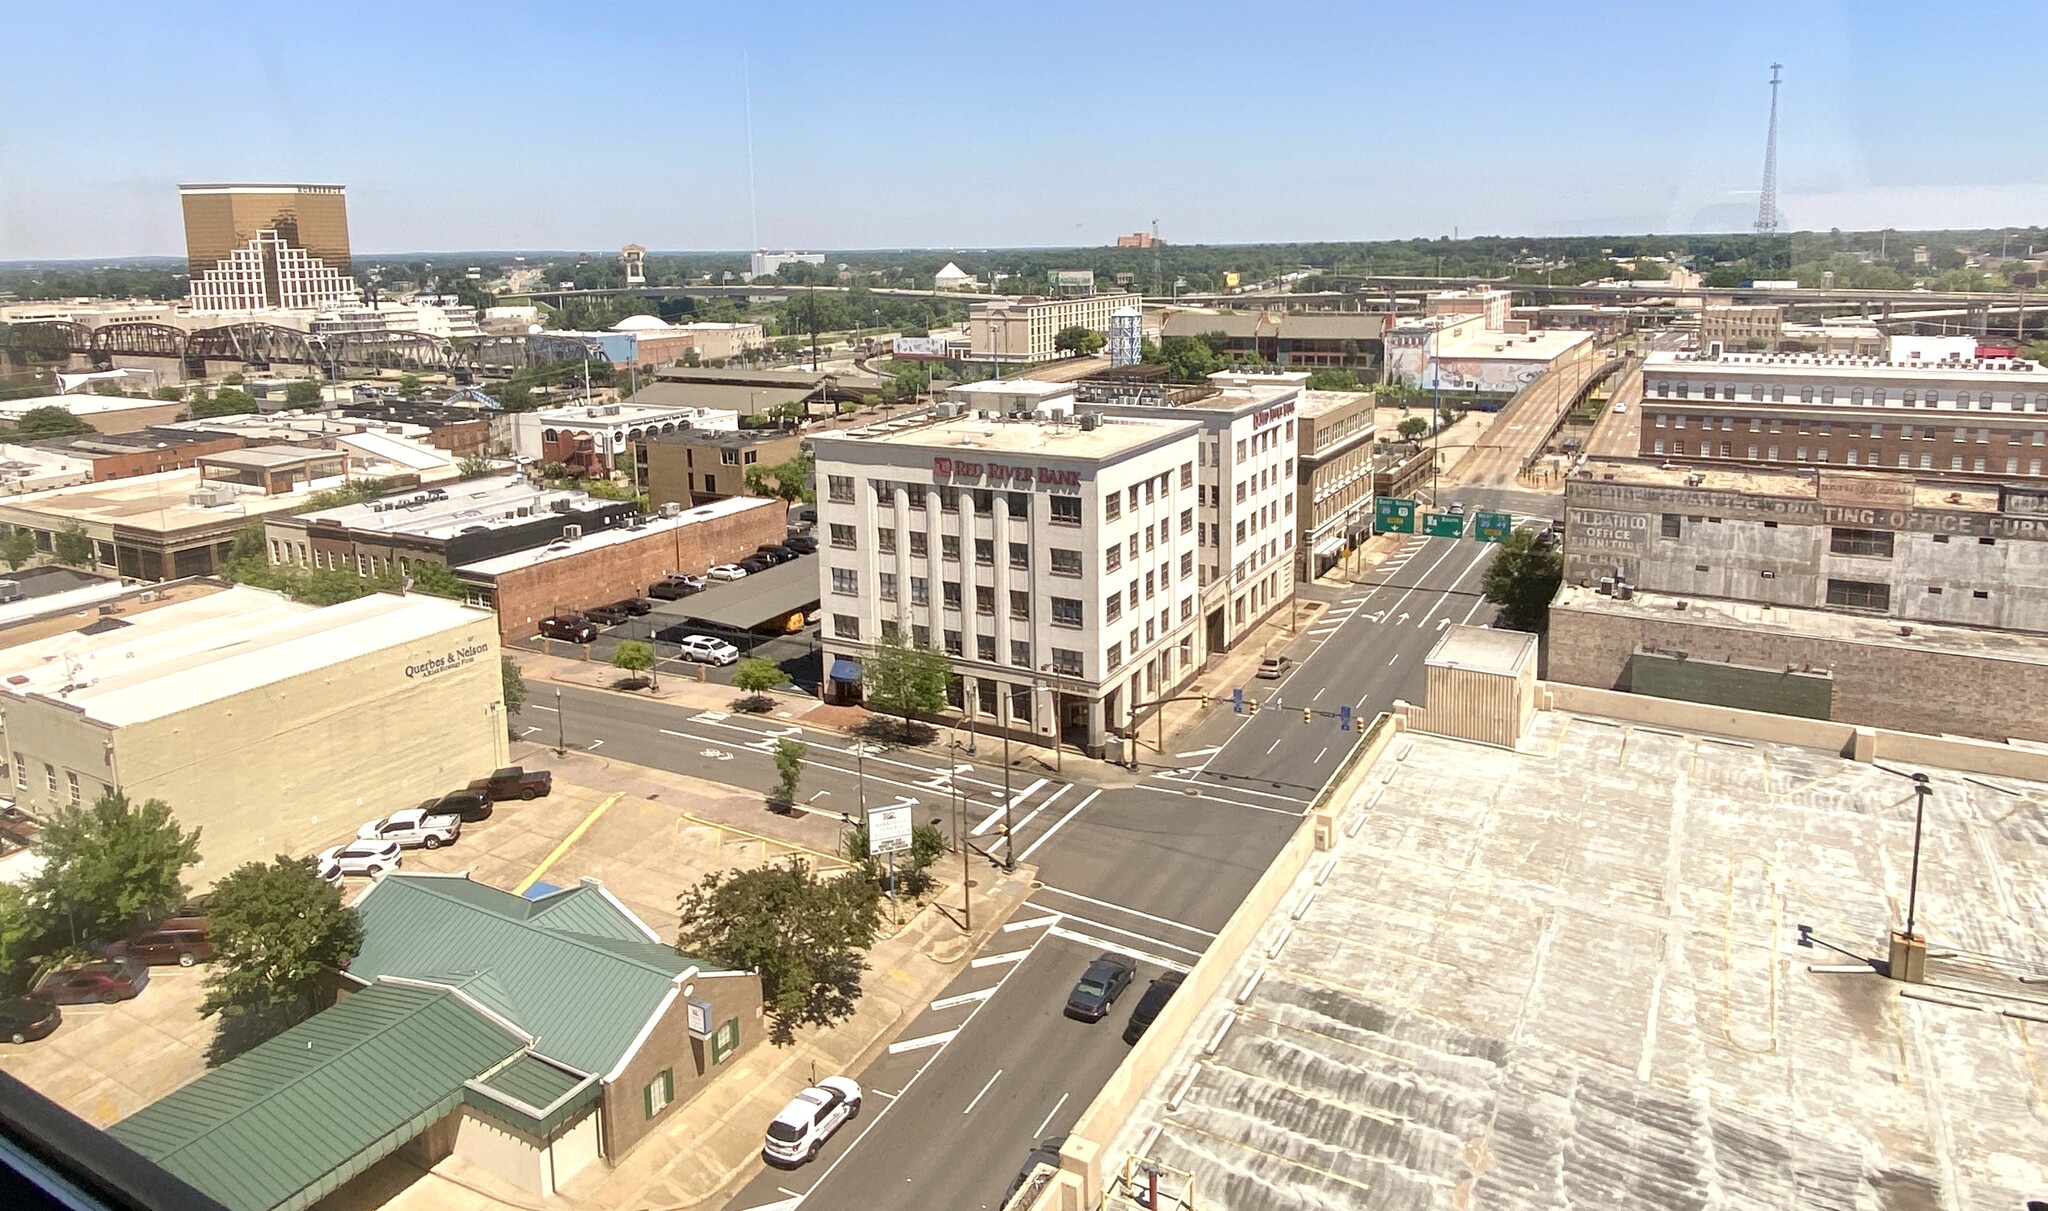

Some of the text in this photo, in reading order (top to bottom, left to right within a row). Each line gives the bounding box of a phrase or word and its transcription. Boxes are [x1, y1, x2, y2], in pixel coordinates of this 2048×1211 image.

[954, 460, 1081, 487] RED RIVER BANK
[1586, 527, 1631, 540] OFFICE
[1889, 511, 1972, 534] OFFICE
[405, 643, 489, 678] Querbes & Nelson
